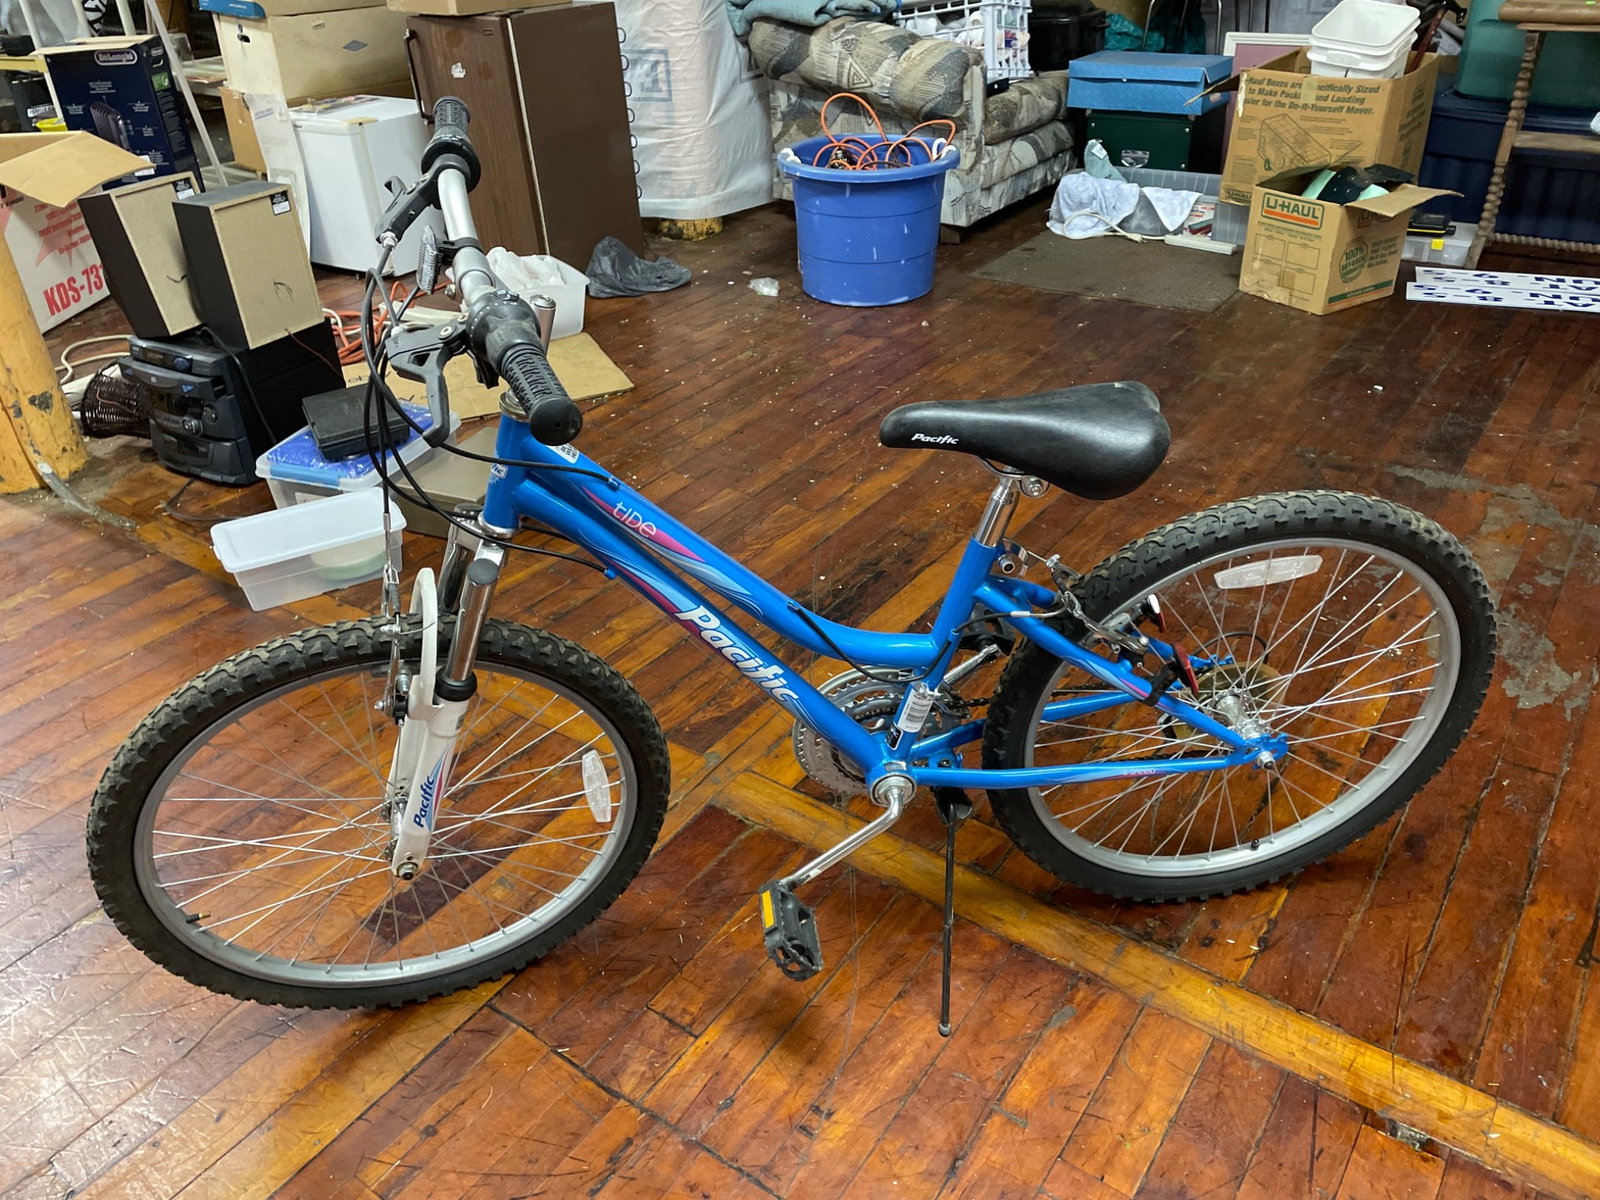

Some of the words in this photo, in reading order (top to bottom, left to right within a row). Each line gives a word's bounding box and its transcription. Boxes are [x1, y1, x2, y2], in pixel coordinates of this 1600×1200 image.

[1355, 85, 1381, 93] Sized
[1257, 88, 1278, 97] Make
[1279, 90, 1301, 99] Packi
[1331, 95, 1366, 105] Loading
[1262, 98, 1273, 106] for
[1274, 100, 1287, 108] the
[1227, 190, 1252, 199] U-HAU
[1266, 197, 1319, 219] U-HAUL
[1517, 275, 1600, 286] UN.
[1529, 282, 1598, 291] AT.
[43, 264, 103, 316] KDS-73
[1511, 291, 1600, 303] UN.
[1524, 298, 1595, 308] AT.
[911, 433, 960, 445] Pacific
[674, 605, 799, 702] Pacific
[413, 776, 435, 828] Pacific
